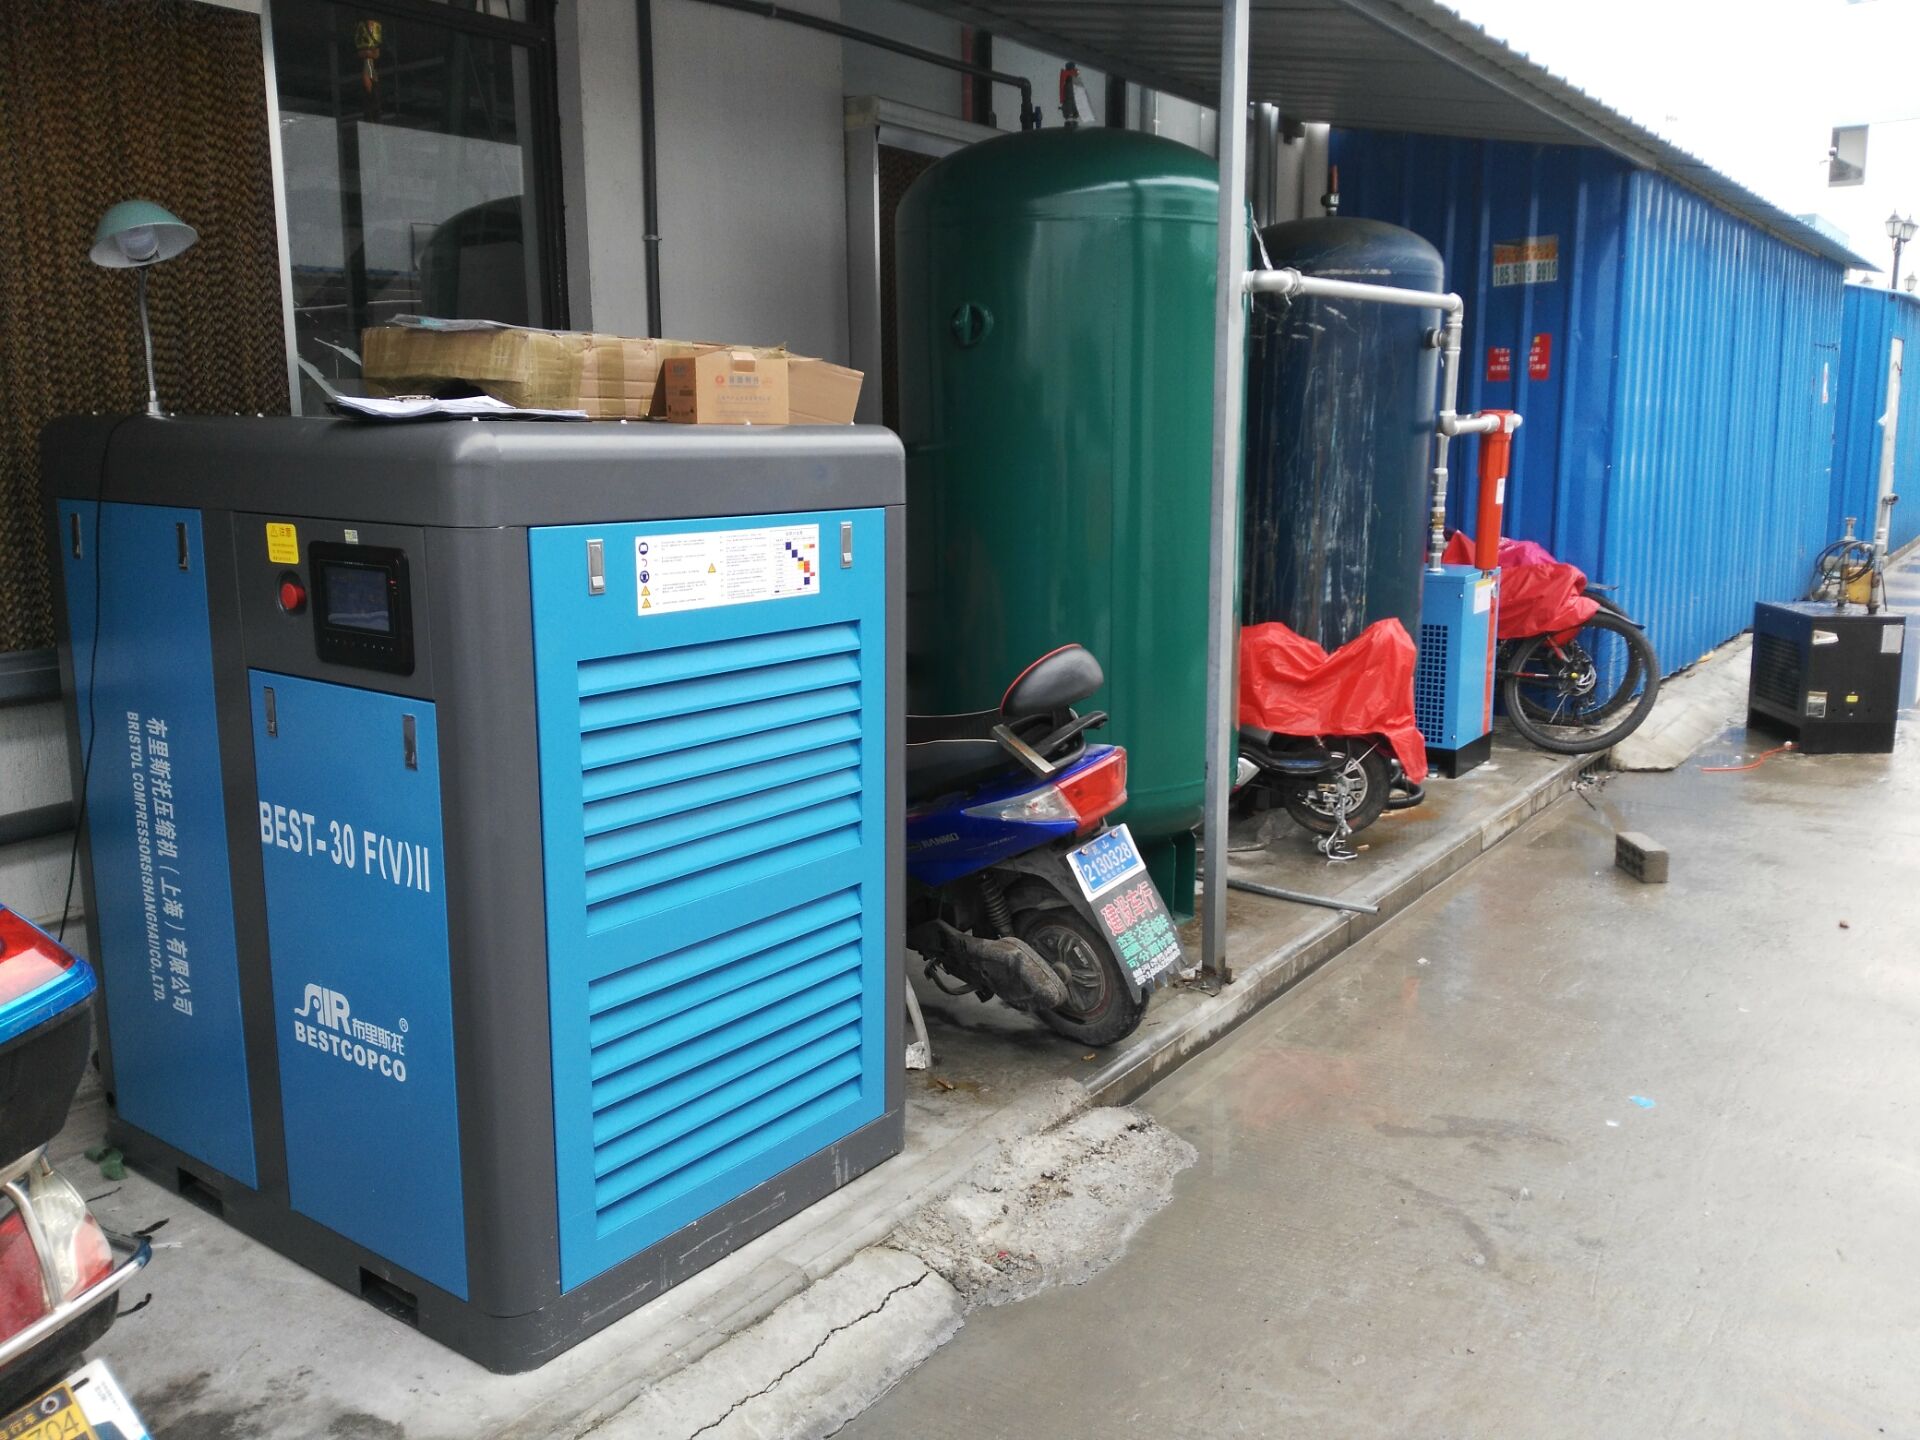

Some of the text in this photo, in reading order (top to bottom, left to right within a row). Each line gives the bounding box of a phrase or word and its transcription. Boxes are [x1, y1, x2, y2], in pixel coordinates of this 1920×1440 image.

[127, 711, 143, 769] BRISTOL
[1084, 842, 1132, 882] 2130328
[1100, 880, 1158, 937] 建设车行
[294, 1021, 407, 1082] BESTCOPCO
[351, 1018, 405, 1056] 布里斯托
